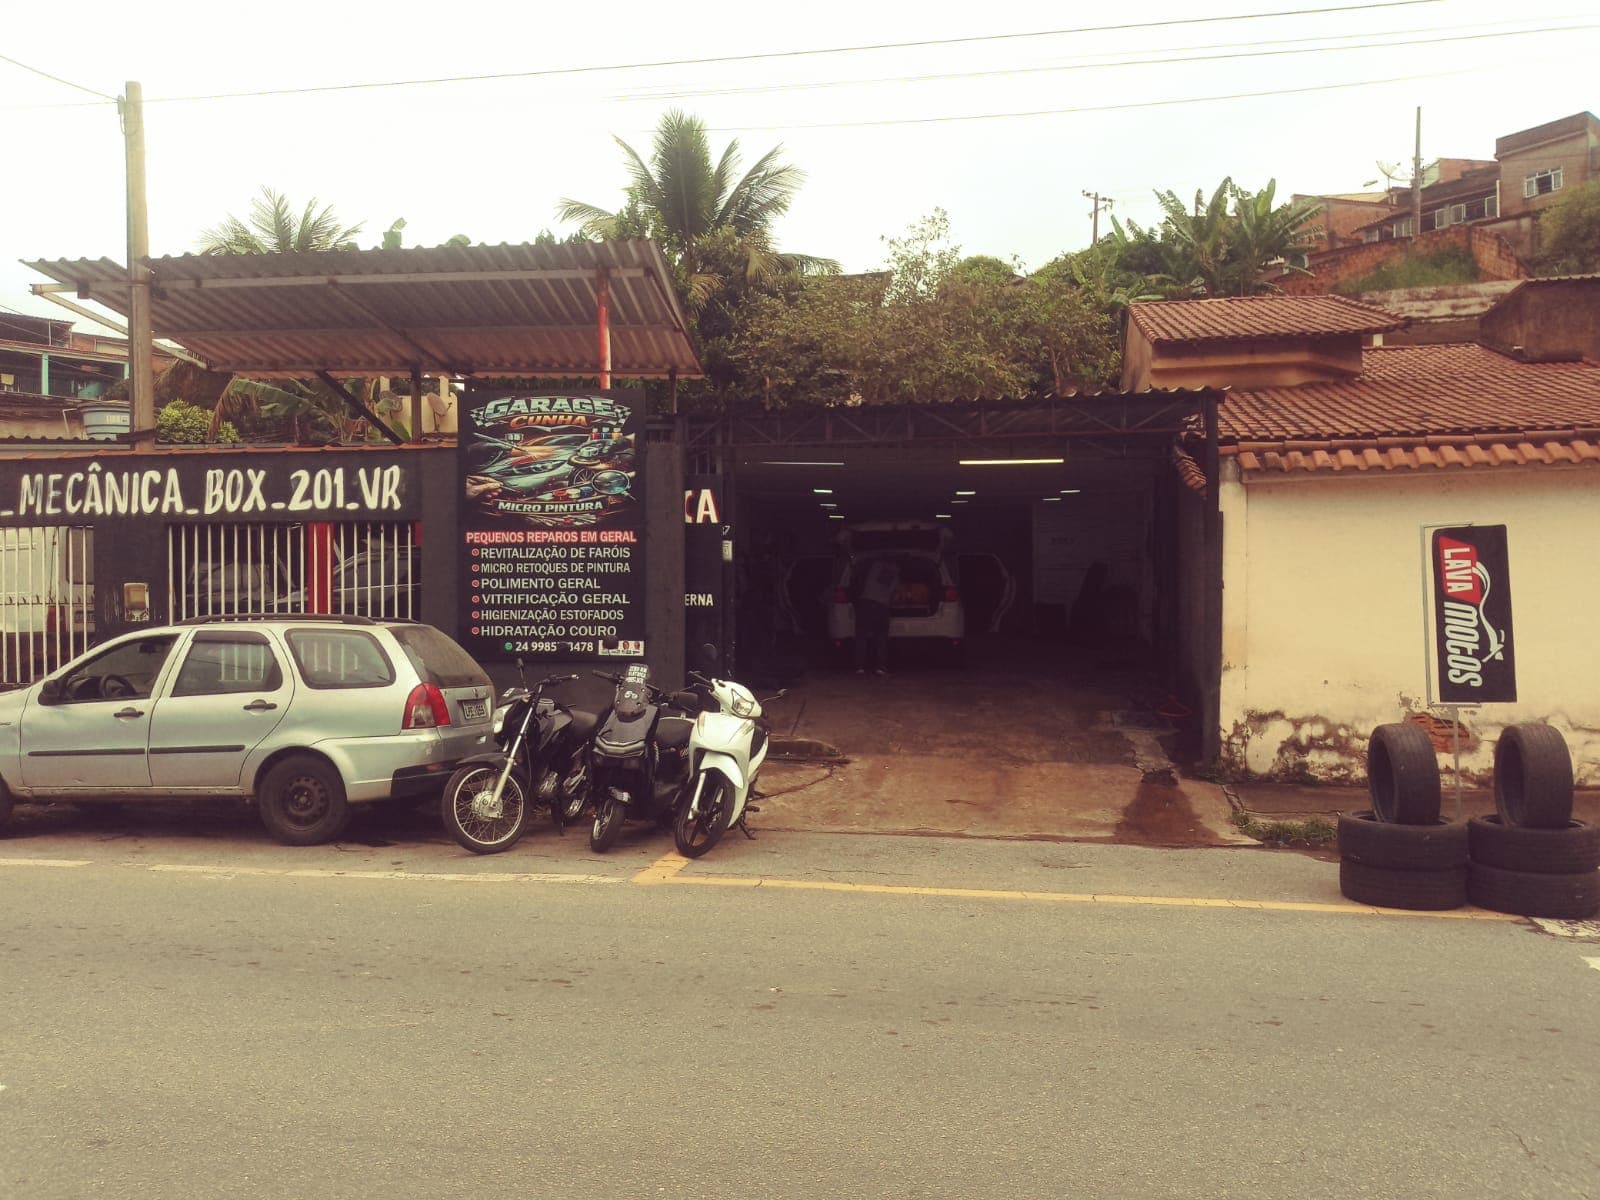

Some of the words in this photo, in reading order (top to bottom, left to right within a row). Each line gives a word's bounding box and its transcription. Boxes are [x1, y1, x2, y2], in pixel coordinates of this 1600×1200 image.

[484, 397, 616, 419] GARAGE
[510, 415, 588, 428] CUNHA
[498, 501, 542, 513] MICRO
[545, 501, 603, 513] PINTURA
[466, 531, 525, 545] PEQUENOS
[527, 531, 578, 543] REPAROS
[581, 531, 597, 543] EM
[600, 531, 637, 543] GERAL
[481, 546, 567, 561] REVITALIZAÇÃO
[570, 547, 586, 559] DE
[589, 545, 631, 558] FARÓIS
[481, 563, 513, 573] MICRO
[516, 563, 568, 575] RETOQUES
[571, 563, 585, 573] DE
[587, 562, 631, 573] PINTURA
[1444, 547, 1473, 593] LAVA
[481, 578, 555, 589] POLIMENTO
[558, 578, 601, 589] GERAL
[482, 592, 578, 607] VITRIFICAÇÃO
[582, 593, 630, 604] GERAL
[481, 608, 557, 622] HIGIENIZAÇÃO
[560, 609, 624, 620] ESTOFADOS
[481, 624, 566, 639] HIDRATAÇÃO
[569, 626, 617, 637] COURO
[515, 641, 528, 651] 24
